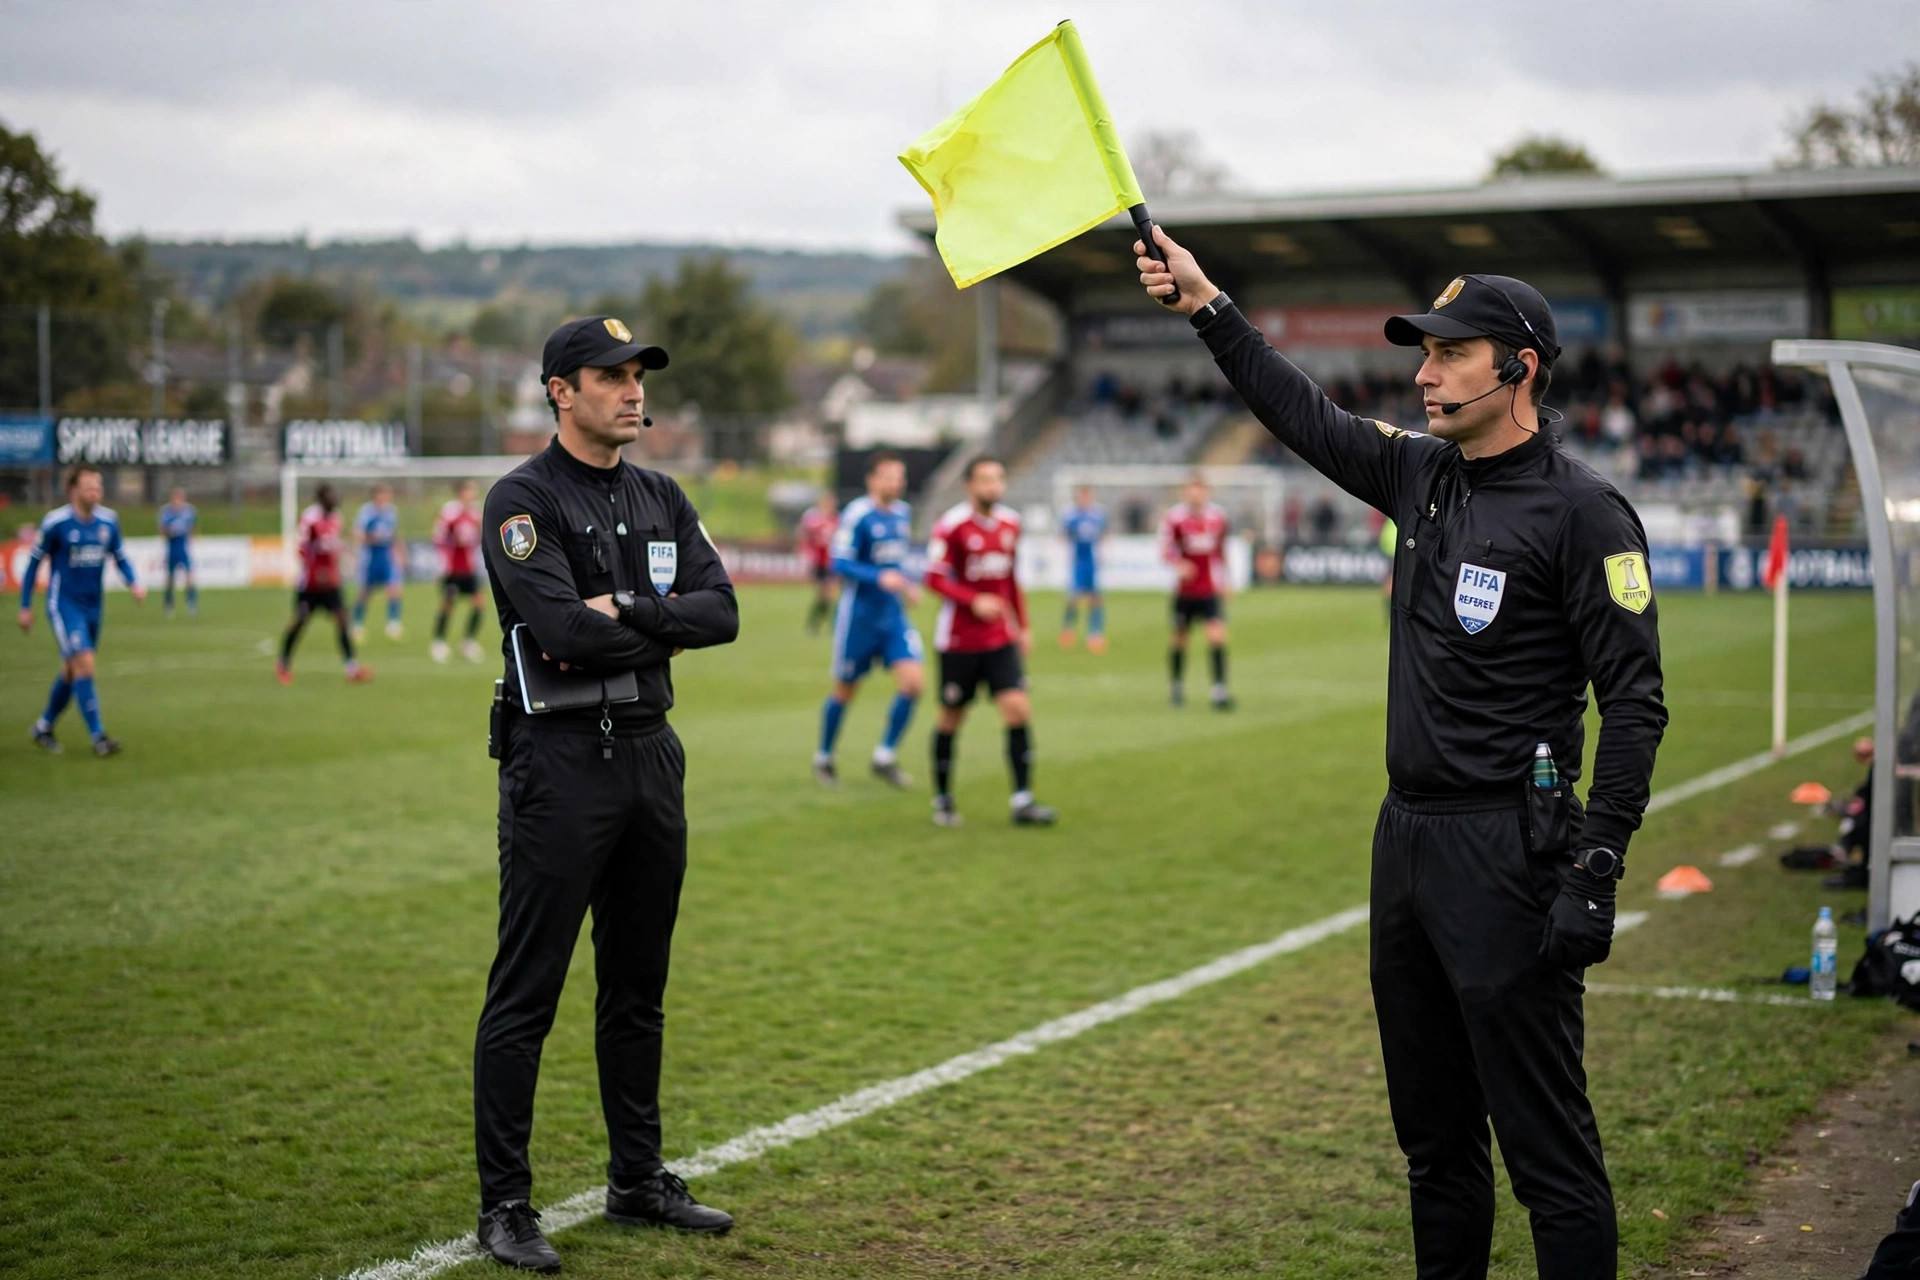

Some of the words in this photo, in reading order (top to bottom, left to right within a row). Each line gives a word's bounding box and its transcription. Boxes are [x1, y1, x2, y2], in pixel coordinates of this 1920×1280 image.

[57, 418, 140, 463] SPORTS
[142, 418, 224, 465] LEAGUE
[285, 419, 407, 464] FOOTBALL
[651, 546, 673, 559] FIFA
[1462, 568, 1499, 592] FIFA
